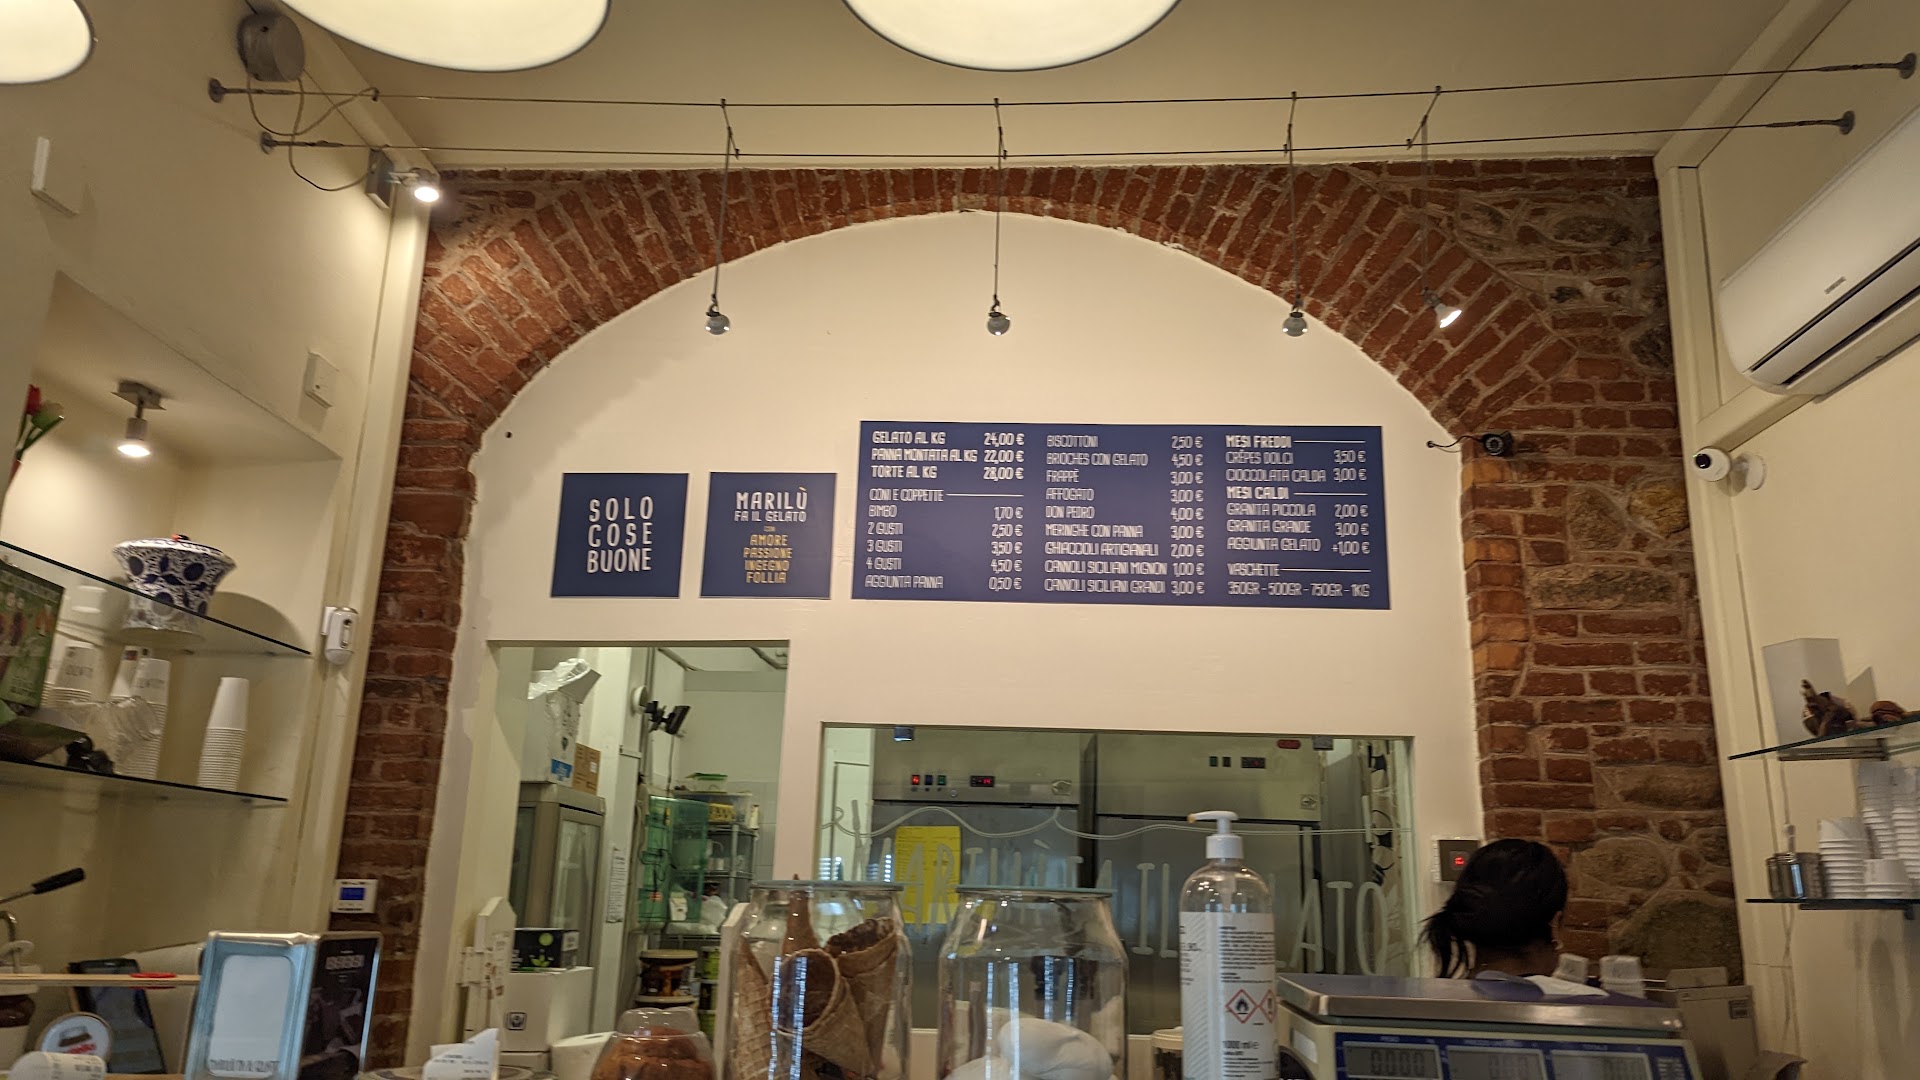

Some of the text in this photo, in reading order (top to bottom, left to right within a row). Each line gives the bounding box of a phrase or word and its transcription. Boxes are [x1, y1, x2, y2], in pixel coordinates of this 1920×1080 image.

[872, 431, 1024, 447] GELATO AL KG 24,00 €
[1046, 435, 1203, 450] BISCOTTONI 2,50 €
[1226, 435, 1292, 448] MESI FREDDI
[871, 449, 1024, 464] PANNA MONTATA AL KG 22,00 €
[1046, 453, 1203, 468] BRIOCHES CON GELATO 4,50 €
[1264, 452, 1293, 464] DOLCI
[1334, 450, 1355, 464] 3,50
[1358, 451, 1366, 463] €
[871, 466, 1024, 481] TORTE AL KG 28,00 €
[1170, 472, 1193, 486] 3,00
[1195, 472, 1203, 484] €
[1226, 468, 1367, 482] CIOCCOLATA CALDA 3,00 €
[736, 487, 808, 510] MARILÙ
[869, 489, 944, 502] CONI E COPPETTE
[1046, 488, 1203, 504] AFFOGATO 3,00 €
[1226, 487, 1289, 499] MESI CALDI
[589, 496, 654, 522] SOLO
[734, 510, 807, 522] FA IL GELATO
[868, 505, 1023, 521] BIMBO 1,70 €
[1046, 506, 1204, 522] DON PEDRO 4,00 €
[1226, 503, 1368, 519] GRANITA PICCOLA 2,00 €
[588, 522, 653, 547] COSE
[868, 522, 1023, 538] 2 GUSTI 2,50 €
[1045, 524, 1204, 540] MERINGHE CON PANNA 3,00 €
[1227, 520, 1369, 538] GRANITA GRANDE 3,00 €
[750, 534, 788, 546] AMORE
[867, 540, 1022, 555] 3 GUSTI 3,50 €
[1227, 538, 1370, 555] AGGIUNTA GELATO +1,00 €
[743, 547, 793, 558] PASSIONE
[1045, 542, 1098, 555] GHIACCIOLI
[1170, 544, 1194, 558] 2,00
[1195, 545, 1204, 557] €
[587, 548, 652, 573] BUONE
[745, 560, 789, 571] INGEGNO
[866, 558, 1022, 573] 4 GUSTI 4,50 €
[1045, 560, 1204, 577] CANNOLI SICILIANI MIGNON 1,00 €
[1227, 563, 1280, 576] VASCHETTE
[746, 572, 787, 584] FOLLIA
[865, 576, 1022, 591] AGGIUNTA PANNA 0,50 €
[1044, 579, 1205, 596] CANNOLI SICILIANI GRANDI 3,00 €
[1228, 582, 1260, 594] 350GR
[1268, 583, 1302, 595] 500GR
[1311, 584, 1342, 596] 750GR
[1351, 584, 1370, 597] 1KG
